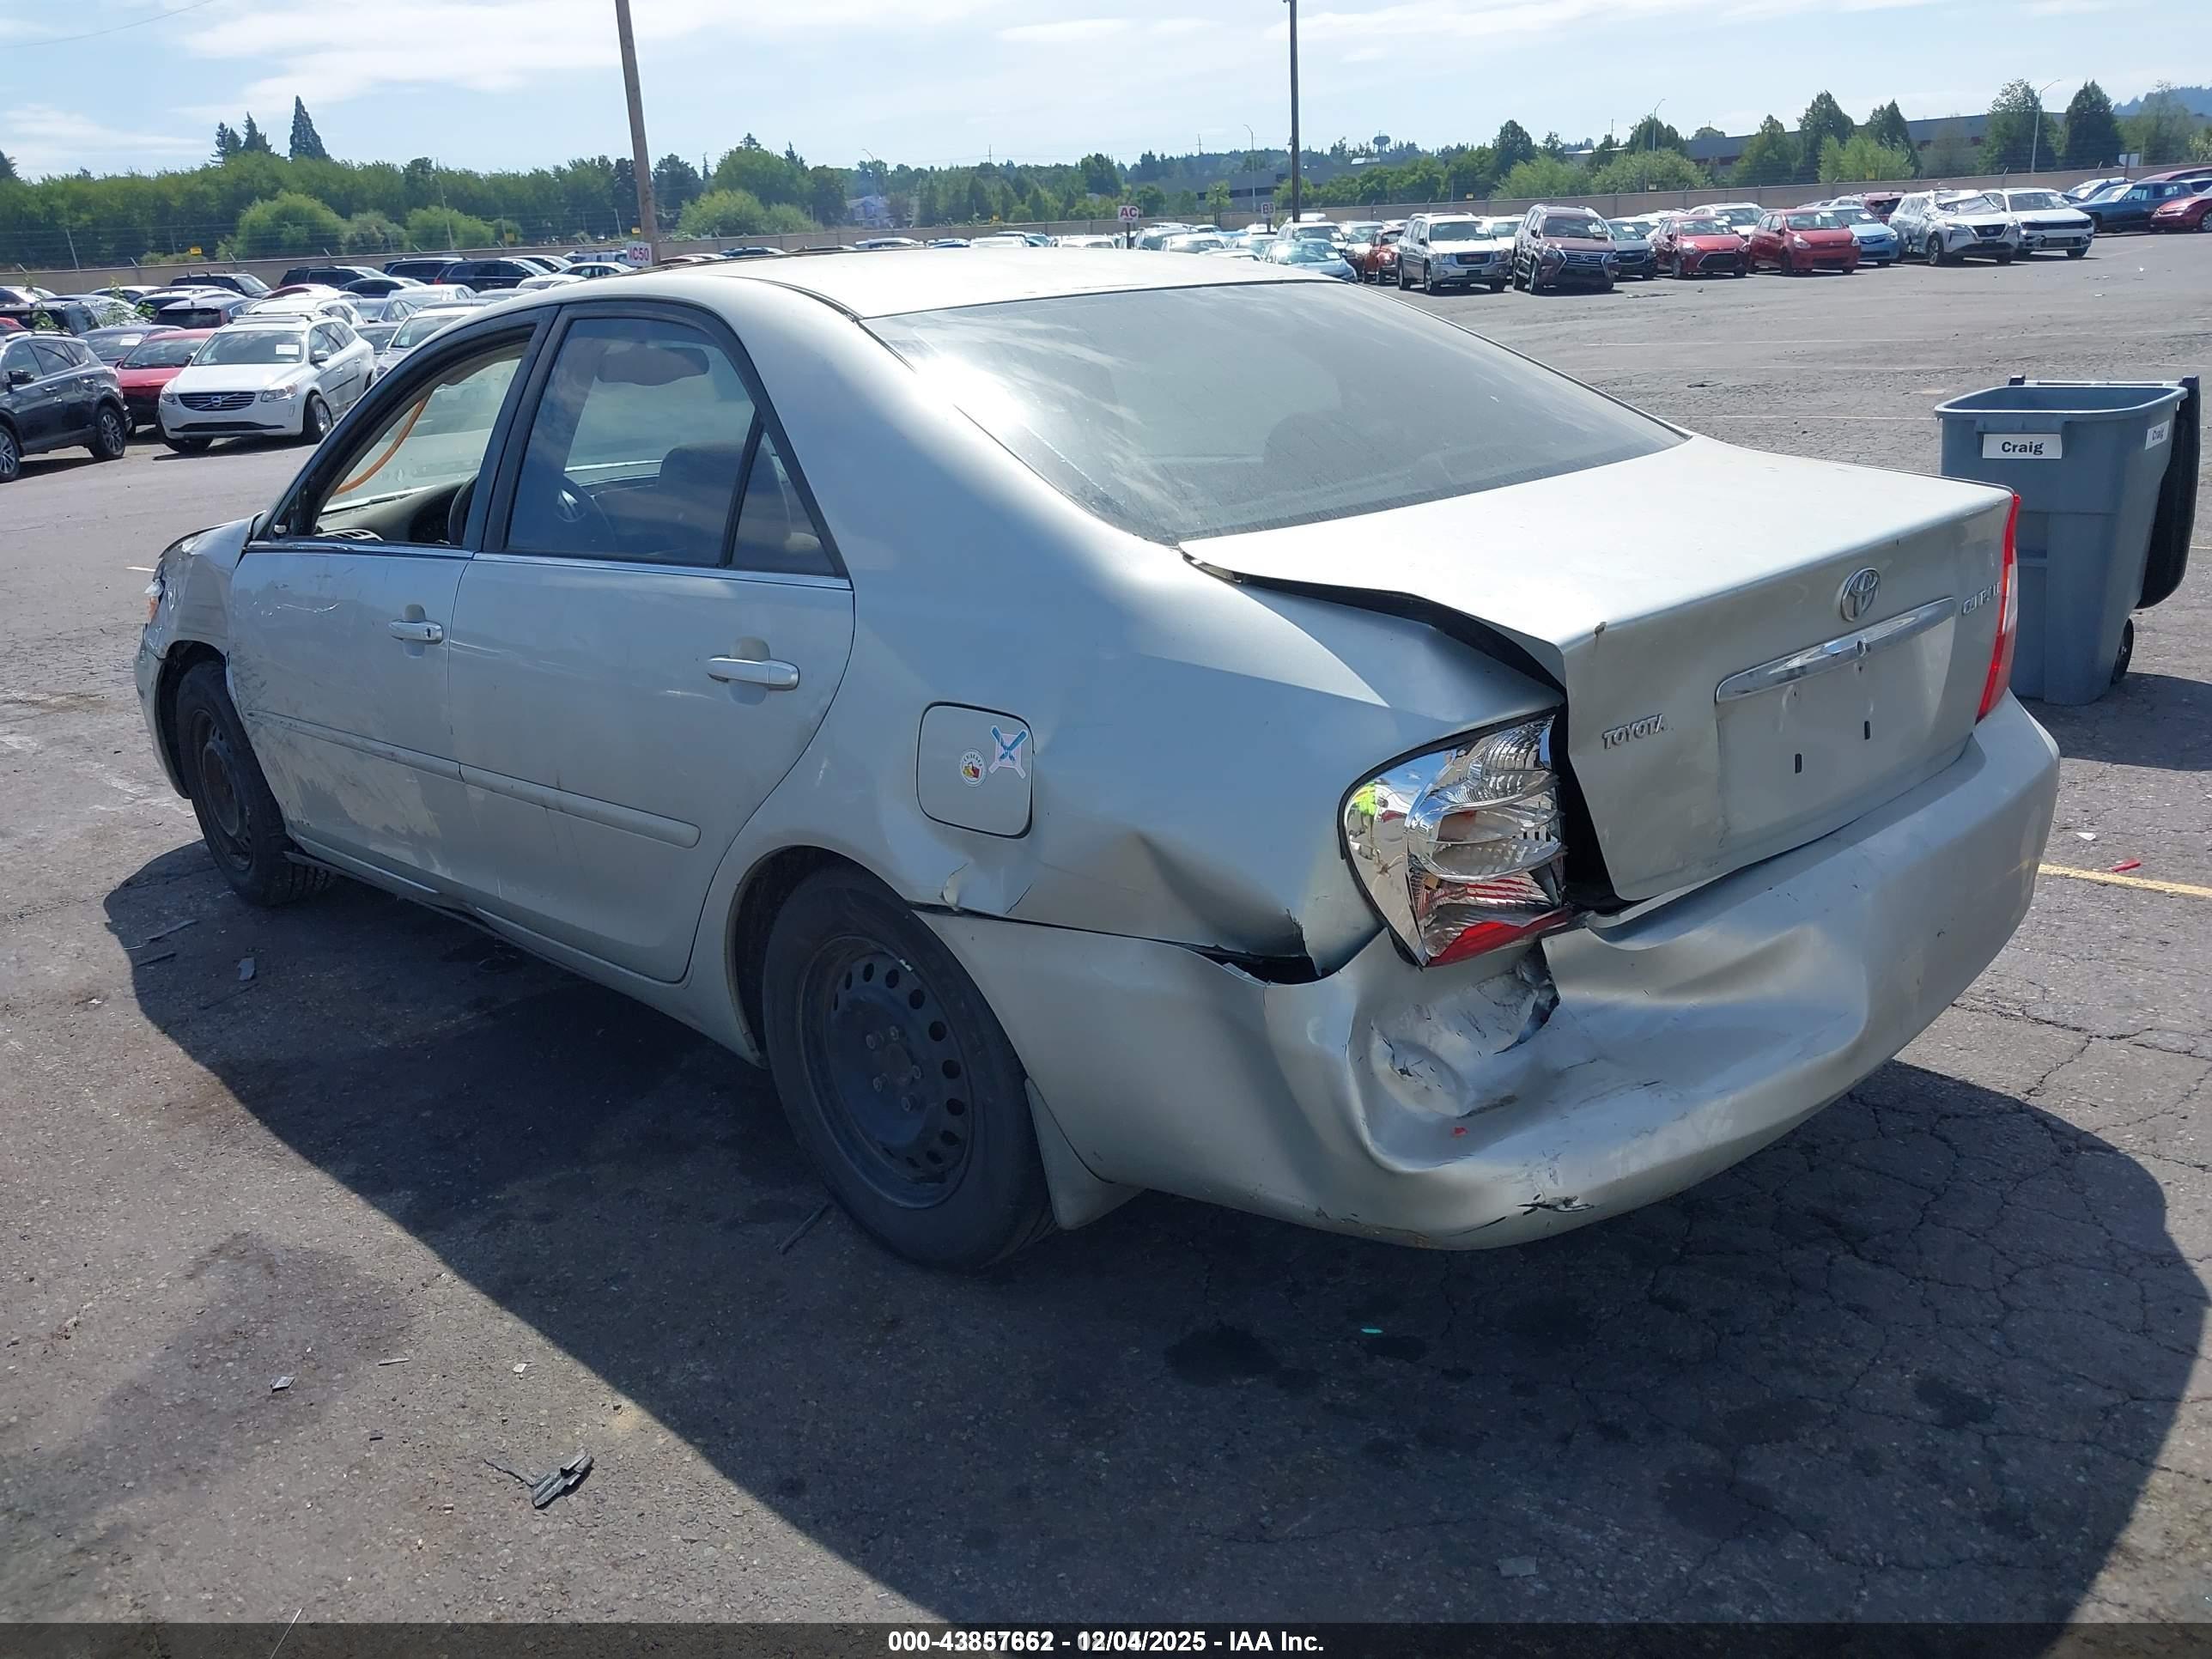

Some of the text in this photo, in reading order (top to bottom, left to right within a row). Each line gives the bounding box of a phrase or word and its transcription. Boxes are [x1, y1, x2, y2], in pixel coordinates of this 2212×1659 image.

[1120, 207, 1137, 217] AC
[2001, 441, 2044, 456] Craig
[1601, 713, 1664, 750] TOYOTA
